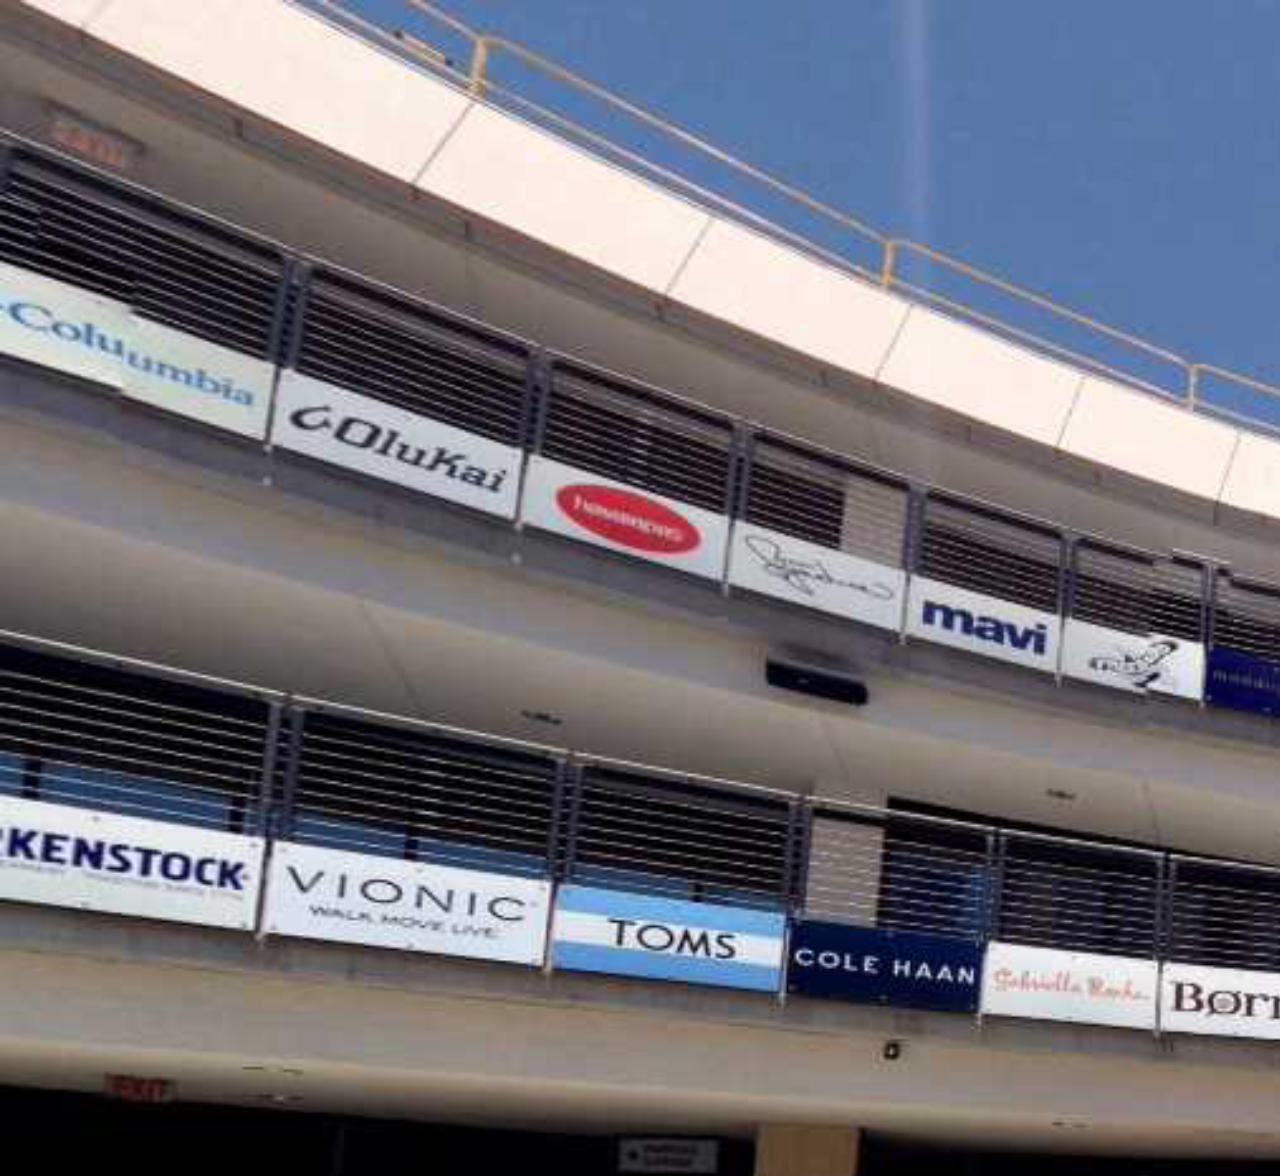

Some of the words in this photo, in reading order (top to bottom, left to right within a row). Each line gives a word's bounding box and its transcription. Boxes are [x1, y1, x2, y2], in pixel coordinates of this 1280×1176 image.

[333, 416, 508, 494] OluKai
[921, 599, 1049, 656] mavi
[0, 827, 245, 890] KENSTOCK
[286, 866, 528, 922] VIONIC
[608, 918, 737, 960] TOMS
[794, 948, 879, 975] COLE
[893, 960, 976, 986] HAAN
